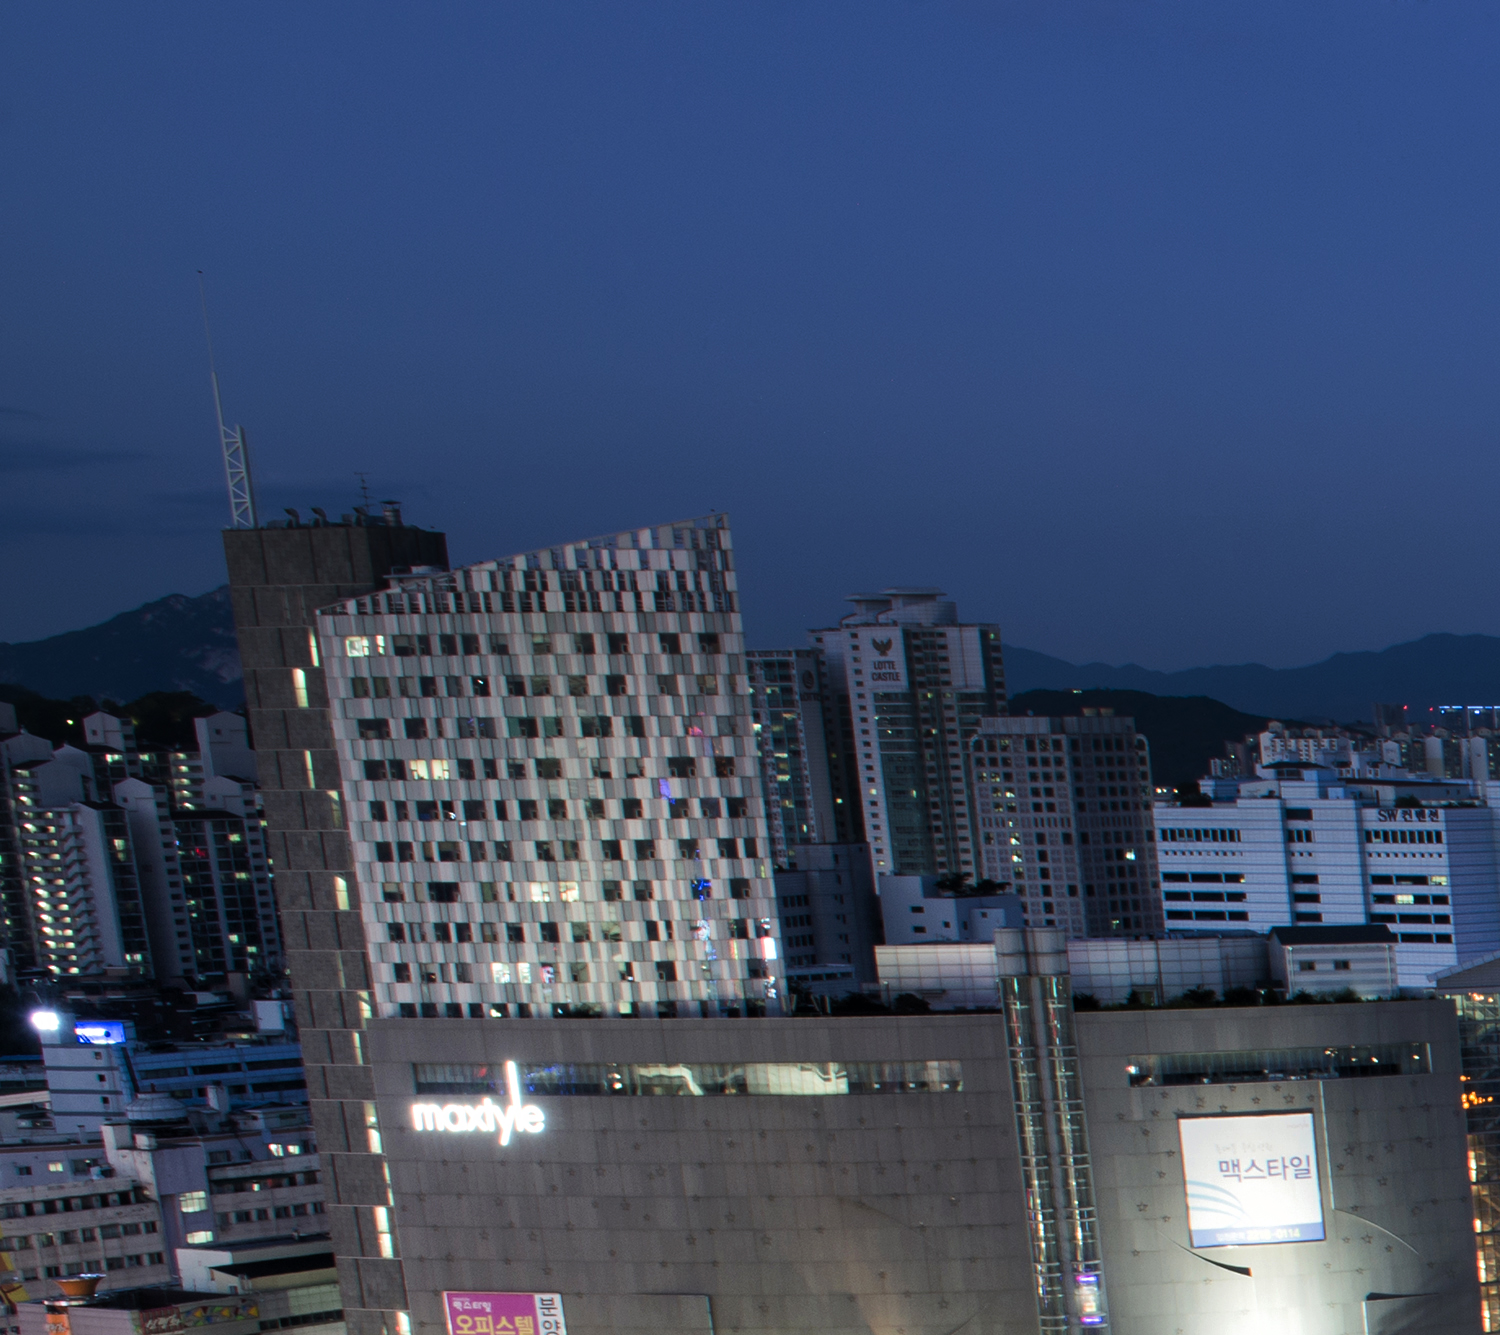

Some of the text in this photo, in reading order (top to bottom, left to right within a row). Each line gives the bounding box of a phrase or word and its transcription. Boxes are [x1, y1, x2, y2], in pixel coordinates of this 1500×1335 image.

[874, 661, 896, 670] LOTTE
[871, 671, 901, 682] CASTLE
[1217, 1154, 1313, 1183] 맥스타일
